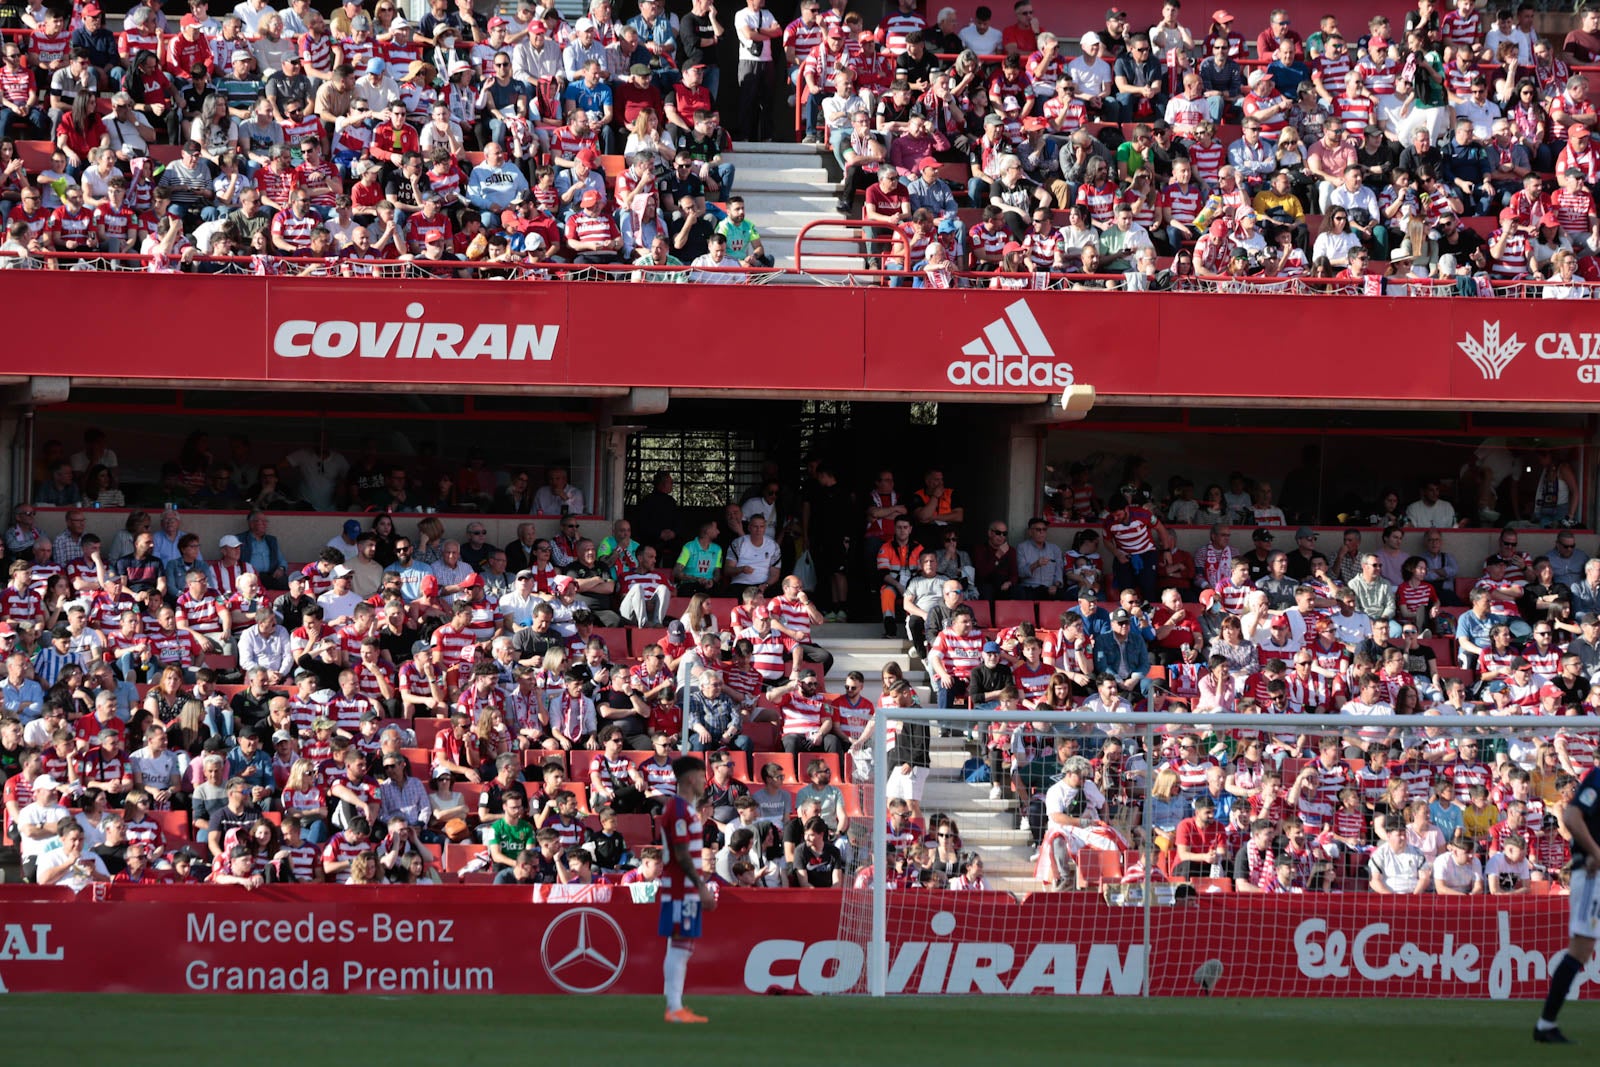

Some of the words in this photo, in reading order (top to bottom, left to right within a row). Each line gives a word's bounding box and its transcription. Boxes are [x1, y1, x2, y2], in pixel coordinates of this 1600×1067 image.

[946, 355, 1075, 387] adidas
[186, 911, 454, 943] Mercedes-Benz
[1293, 918, 1349, 979] El
[1353, 922, 1481, 983] Corte
[186, 959, 329, 991] Granada
[343, 960, 494, 991] Premium
